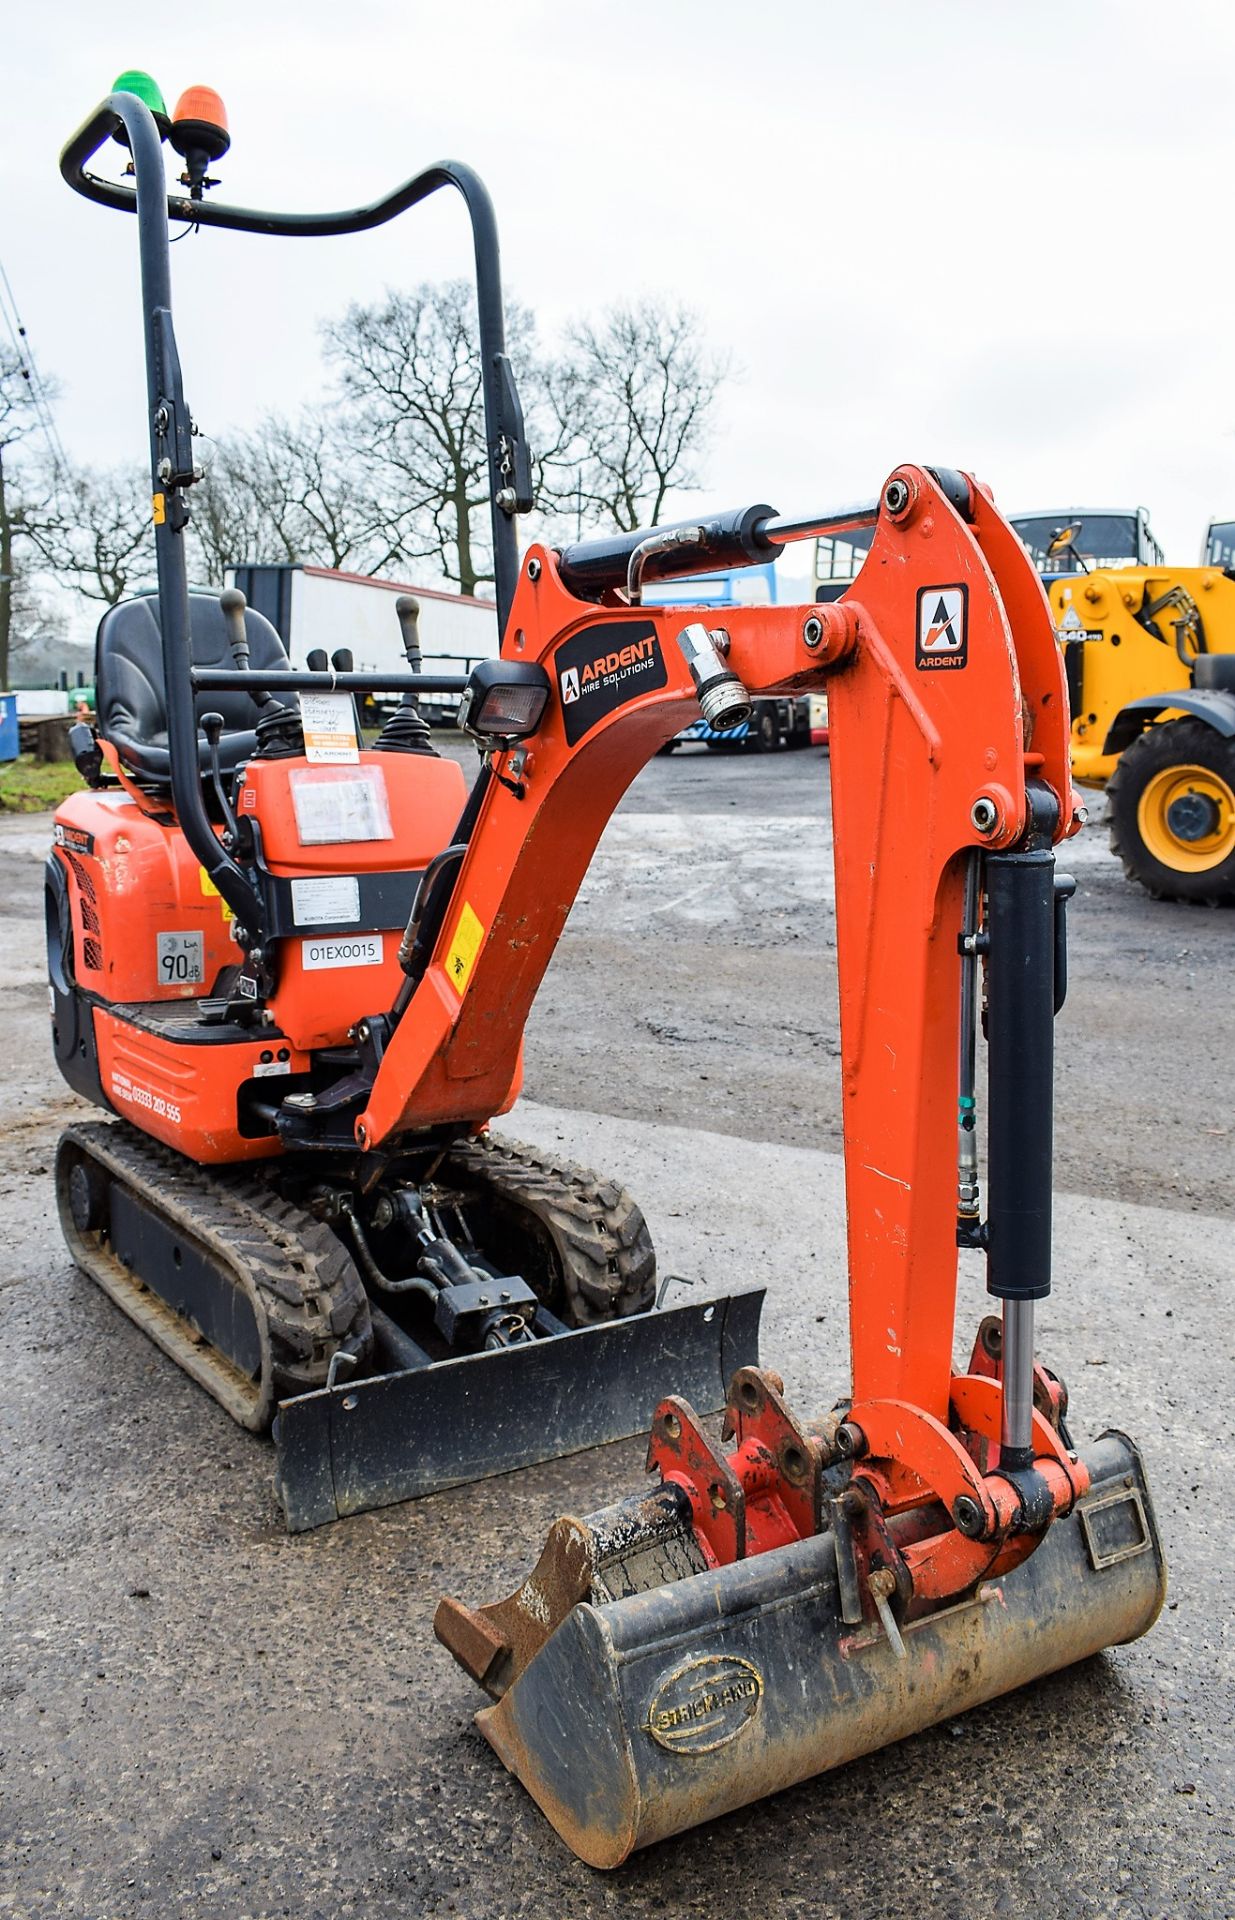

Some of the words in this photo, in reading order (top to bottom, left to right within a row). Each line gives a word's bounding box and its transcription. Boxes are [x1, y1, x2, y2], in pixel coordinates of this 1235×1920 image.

[581, 636, 656, 684] ARDENT
[919, 656, 963, 667] ARDENT
[581, 680, 601, 696] HIRE
[602, 657, 655, 687] SOLUTIONS
[310, 943, 376, 961] 01EX0015
[162, 954, 188, 980] 90
[188, 964, 200, 978] dB
[152, 1096, 167, 1117] 202
[166, 1103, 181, 1124] 555
[655, 1681, 757, 1730] STRICKLAND
